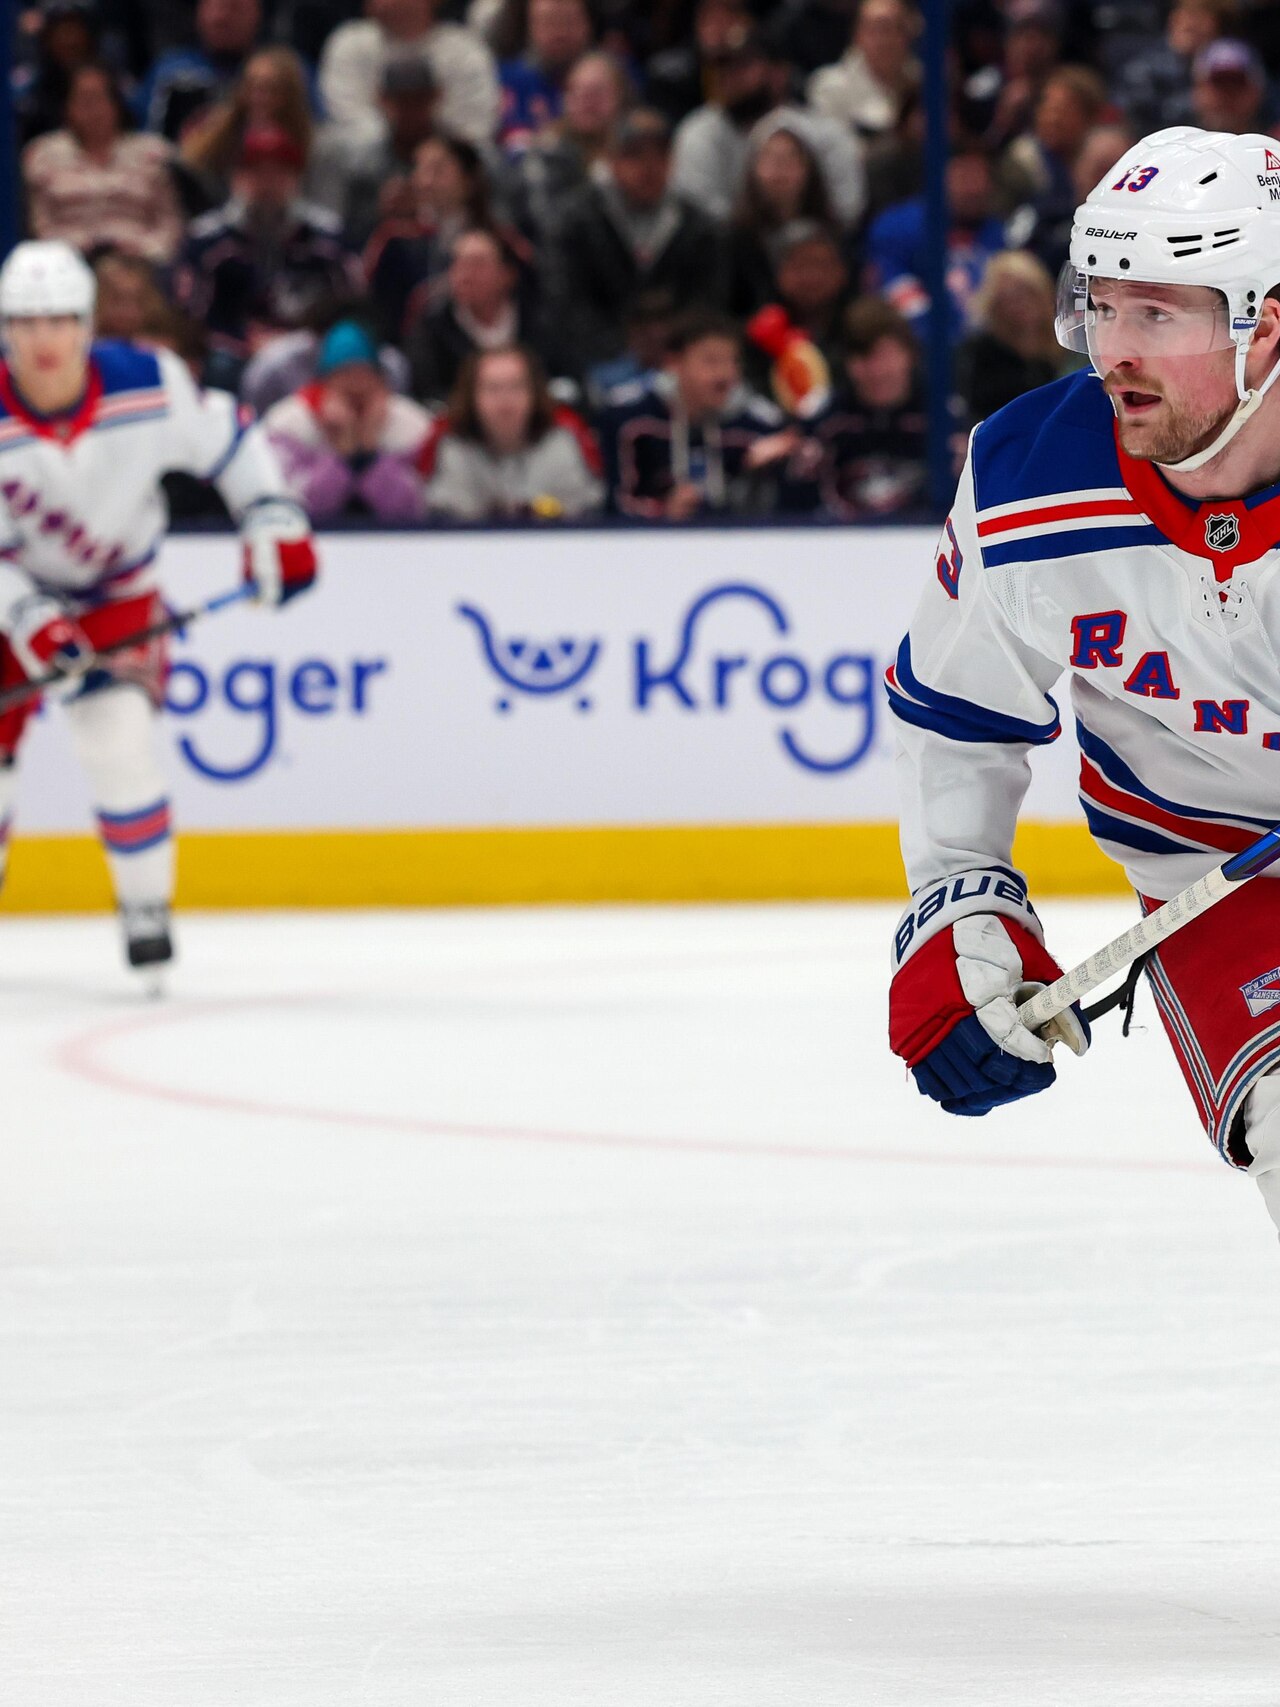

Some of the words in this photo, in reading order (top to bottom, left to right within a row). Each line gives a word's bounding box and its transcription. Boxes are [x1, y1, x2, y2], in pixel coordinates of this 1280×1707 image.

[1112, 165, 1159, 192] 13
[1085, 227, 1137, 241] BAUER
[1212, 523, 1233, 543] NHL
[635, 582, 876, 773] Krog
[165, 656, 386, 782] oger
[1245, 981, 1259, 996] NEW
[1260, 971, 1278, 985] YORK
